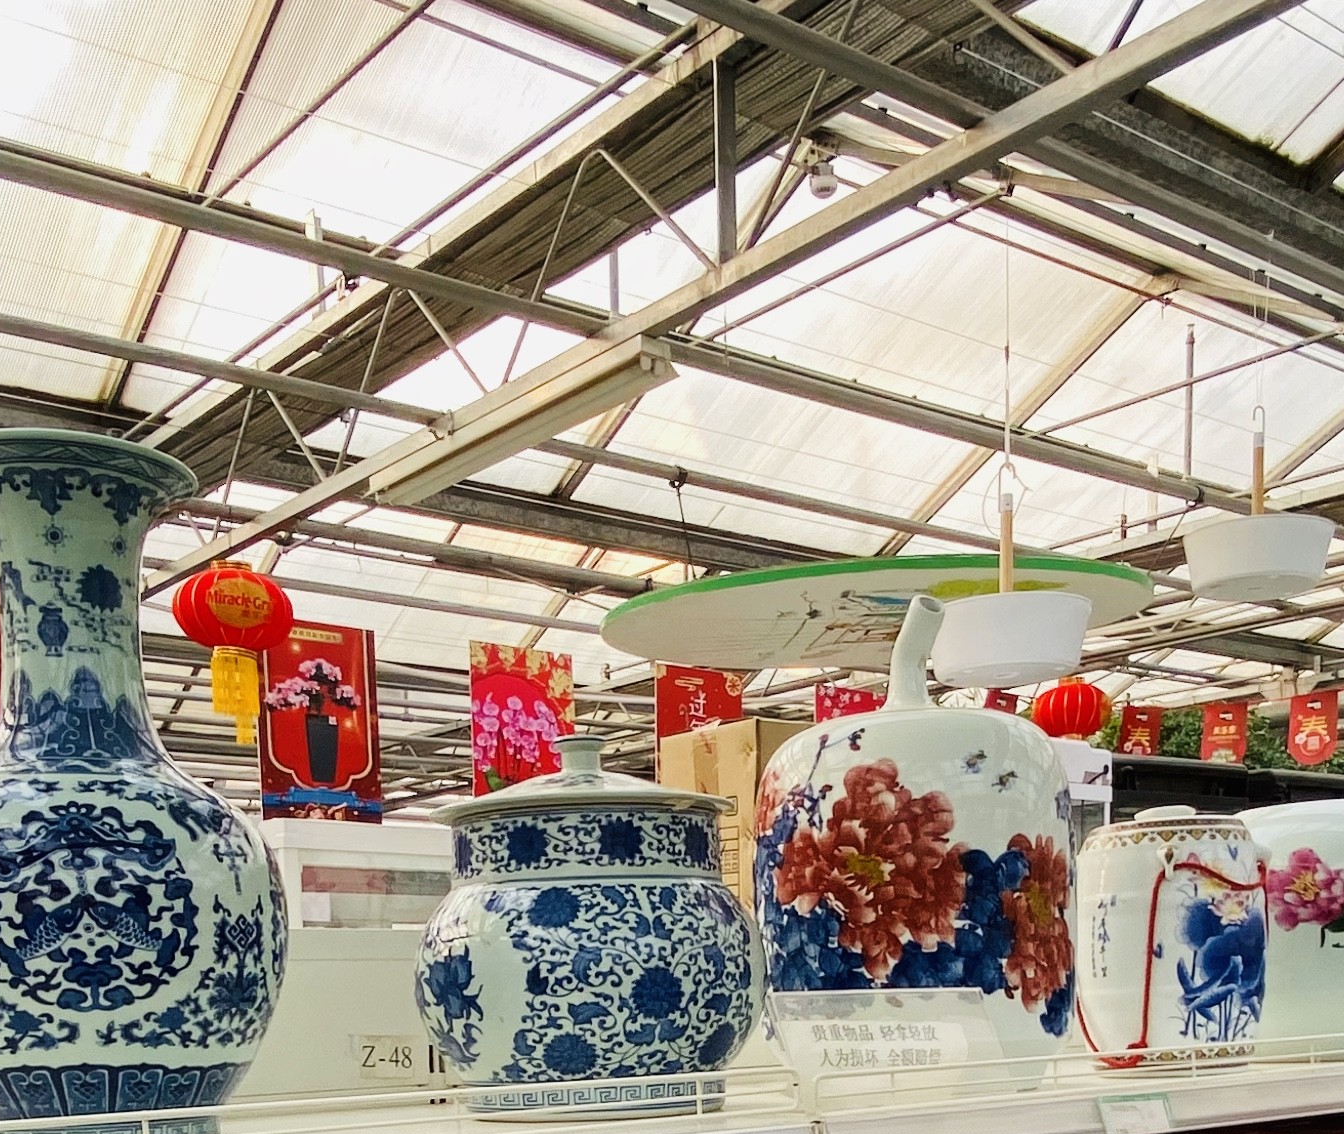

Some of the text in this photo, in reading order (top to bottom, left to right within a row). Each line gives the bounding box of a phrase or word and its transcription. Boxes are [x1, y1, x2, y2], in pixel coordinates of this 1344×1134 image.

[1298, 714, 1328, 737] 春
[1128, 726, 1151, 746] 春
[811, 1024, 938, 1042] 贵重物品 轻拿轻放
[362, 1045, 412, 1068] Z-48
[820, 1048, 942, 1067] 人为损坏 全额赔偿
